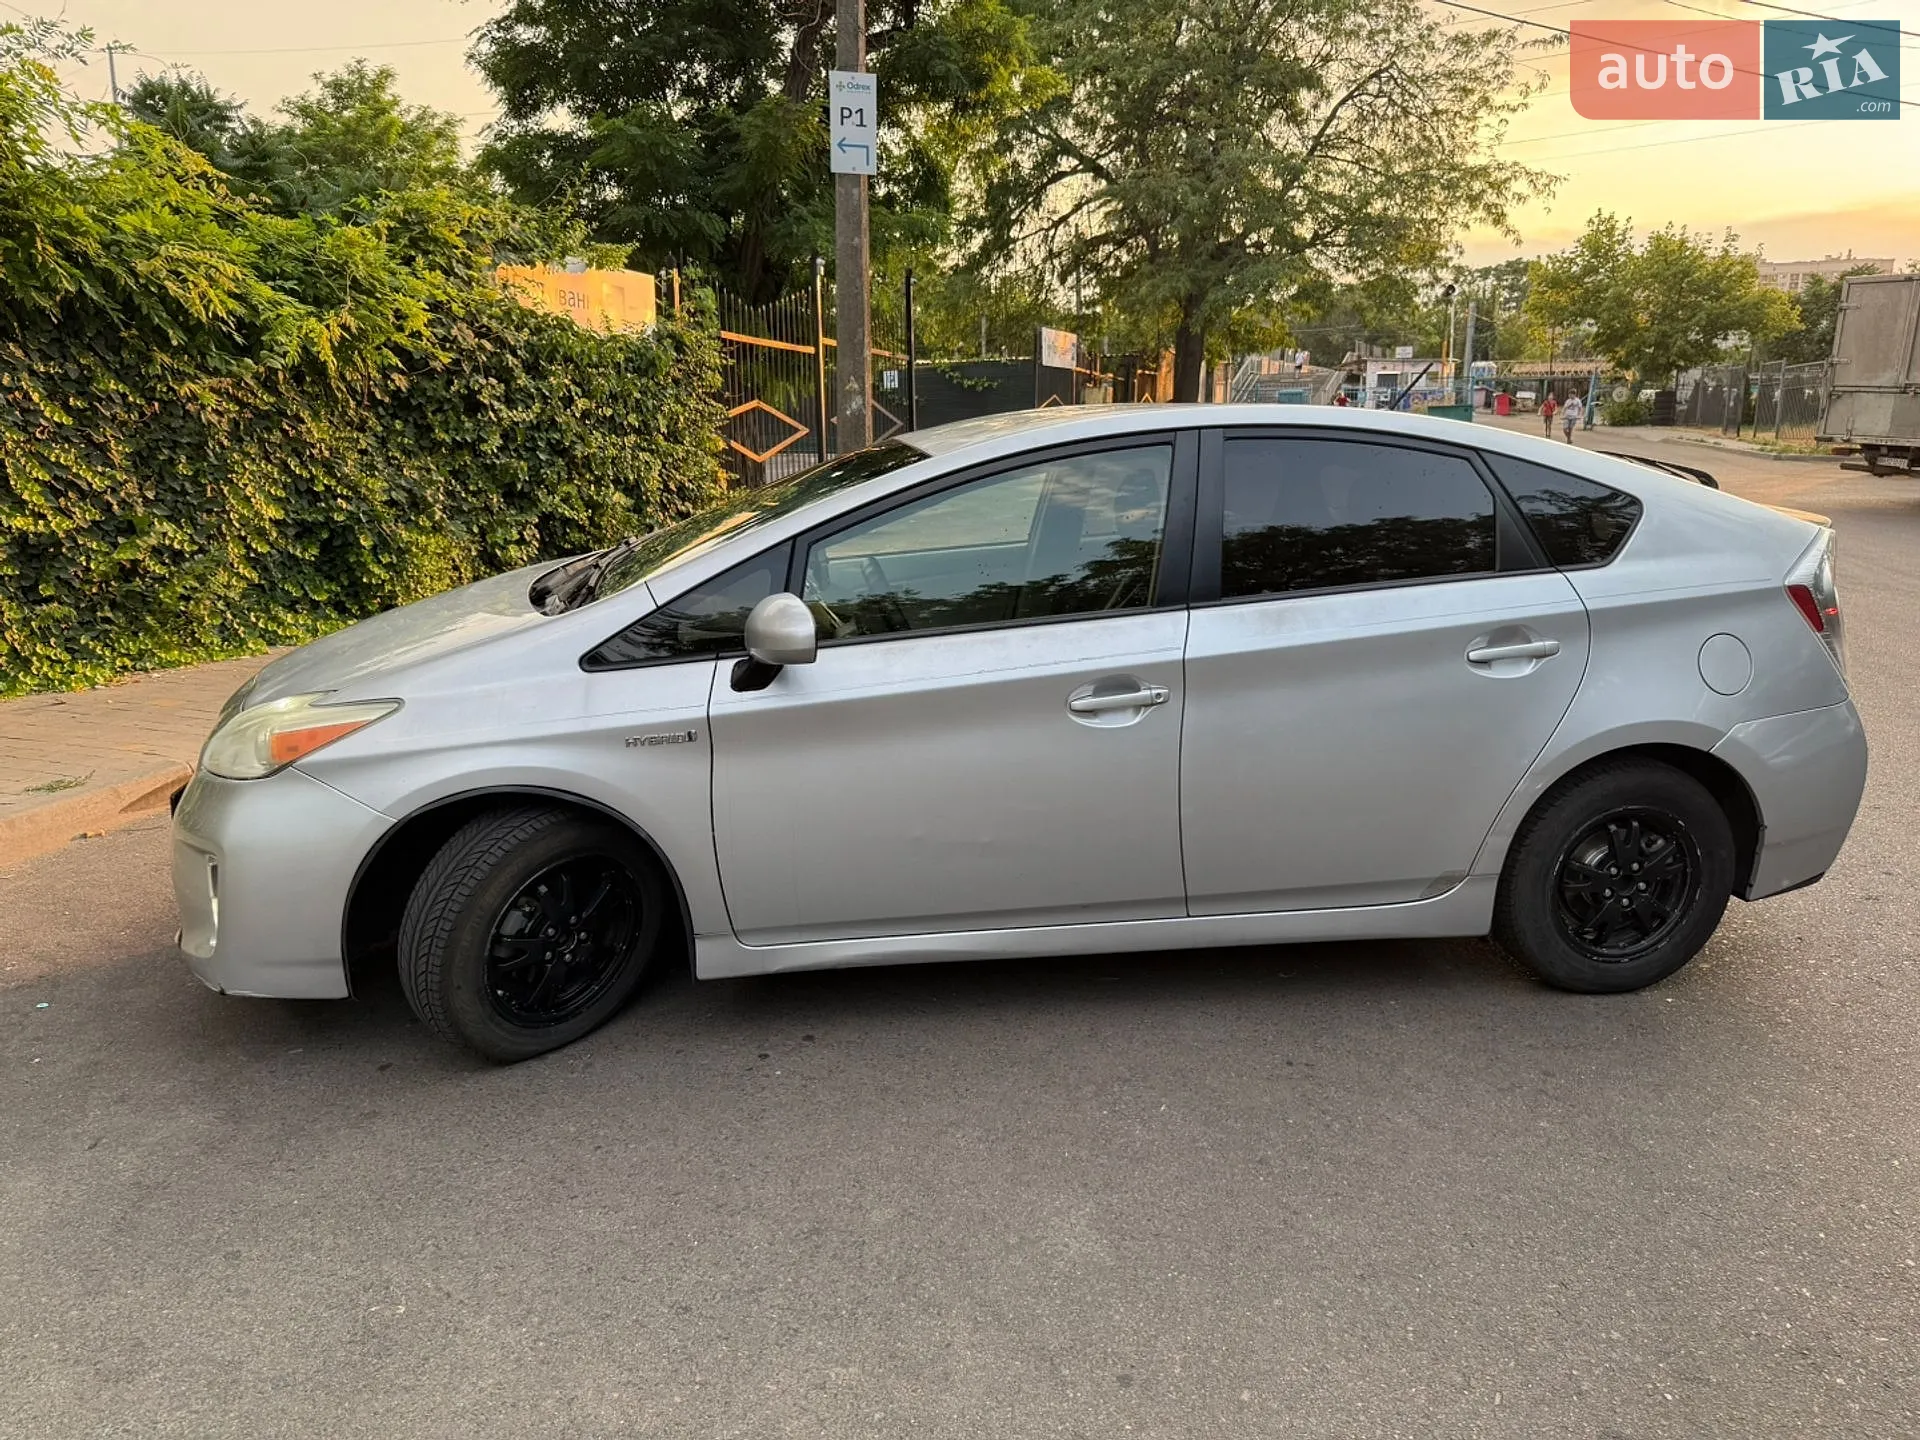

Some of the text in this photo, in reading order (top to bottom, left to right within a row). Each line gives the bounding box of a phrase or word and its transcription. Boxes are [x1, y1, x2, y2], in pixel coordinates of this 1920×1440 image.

[846, 82, 871, 90] Odrex
[840, 106, 867, 127] P1
[625, 732, 685, 748] HYBRID
